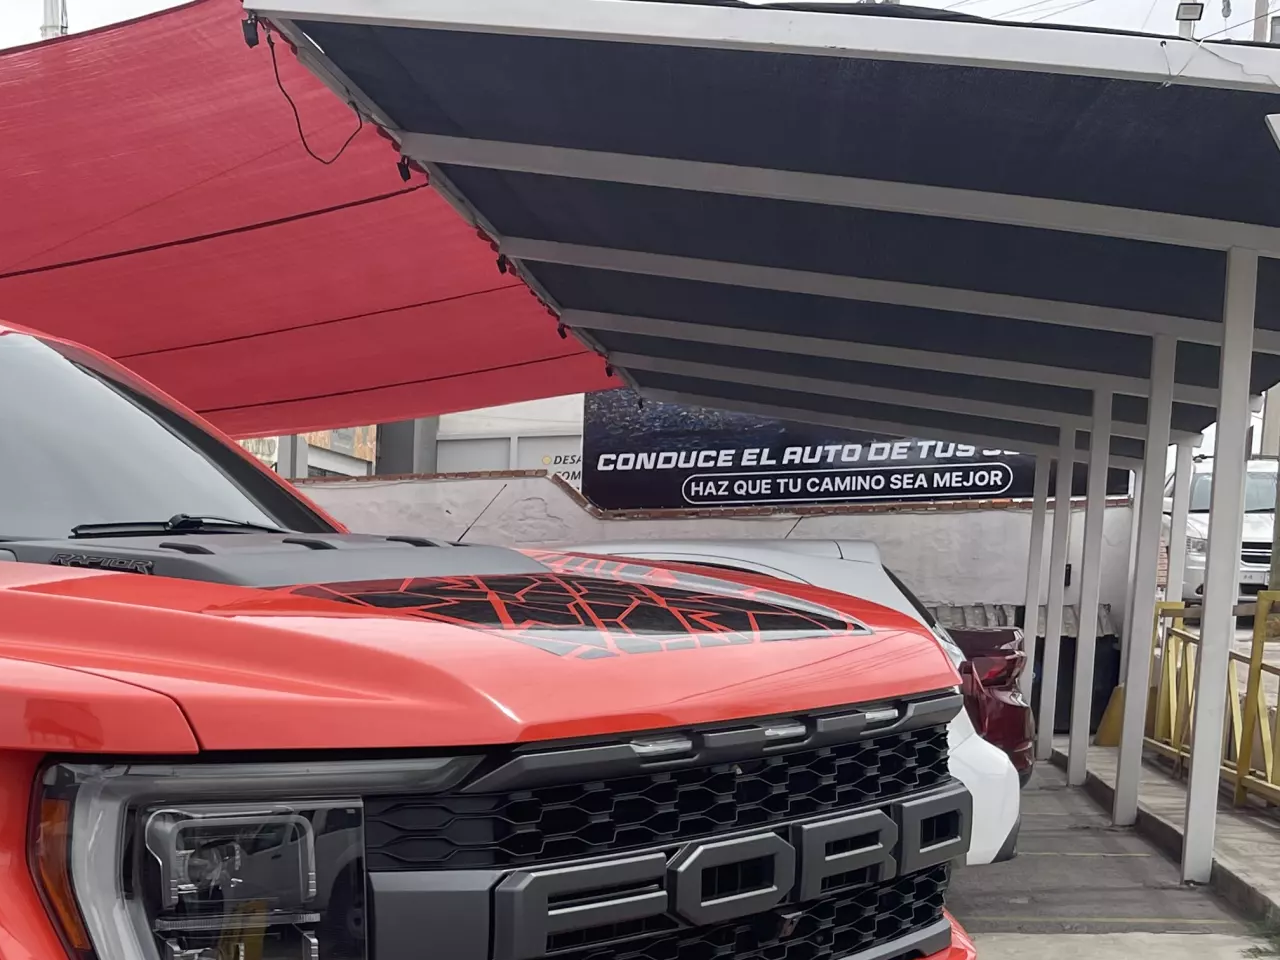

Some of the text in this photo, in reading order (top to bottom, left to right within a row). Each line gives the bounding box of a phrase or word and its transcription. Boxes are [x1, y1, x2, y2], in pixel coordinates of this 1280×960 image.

[597, 449, 736, 471] CONDUCE
[740, 448, 777, 466] EL
[782, 444, 862, 464] AUTO
[867, 441, 912, 461] DE
[690, 471, 1003, 496] HAZ QUE TU CAMINO SEA MEJOR
[50, 554, 154, 575] RAPTOR
